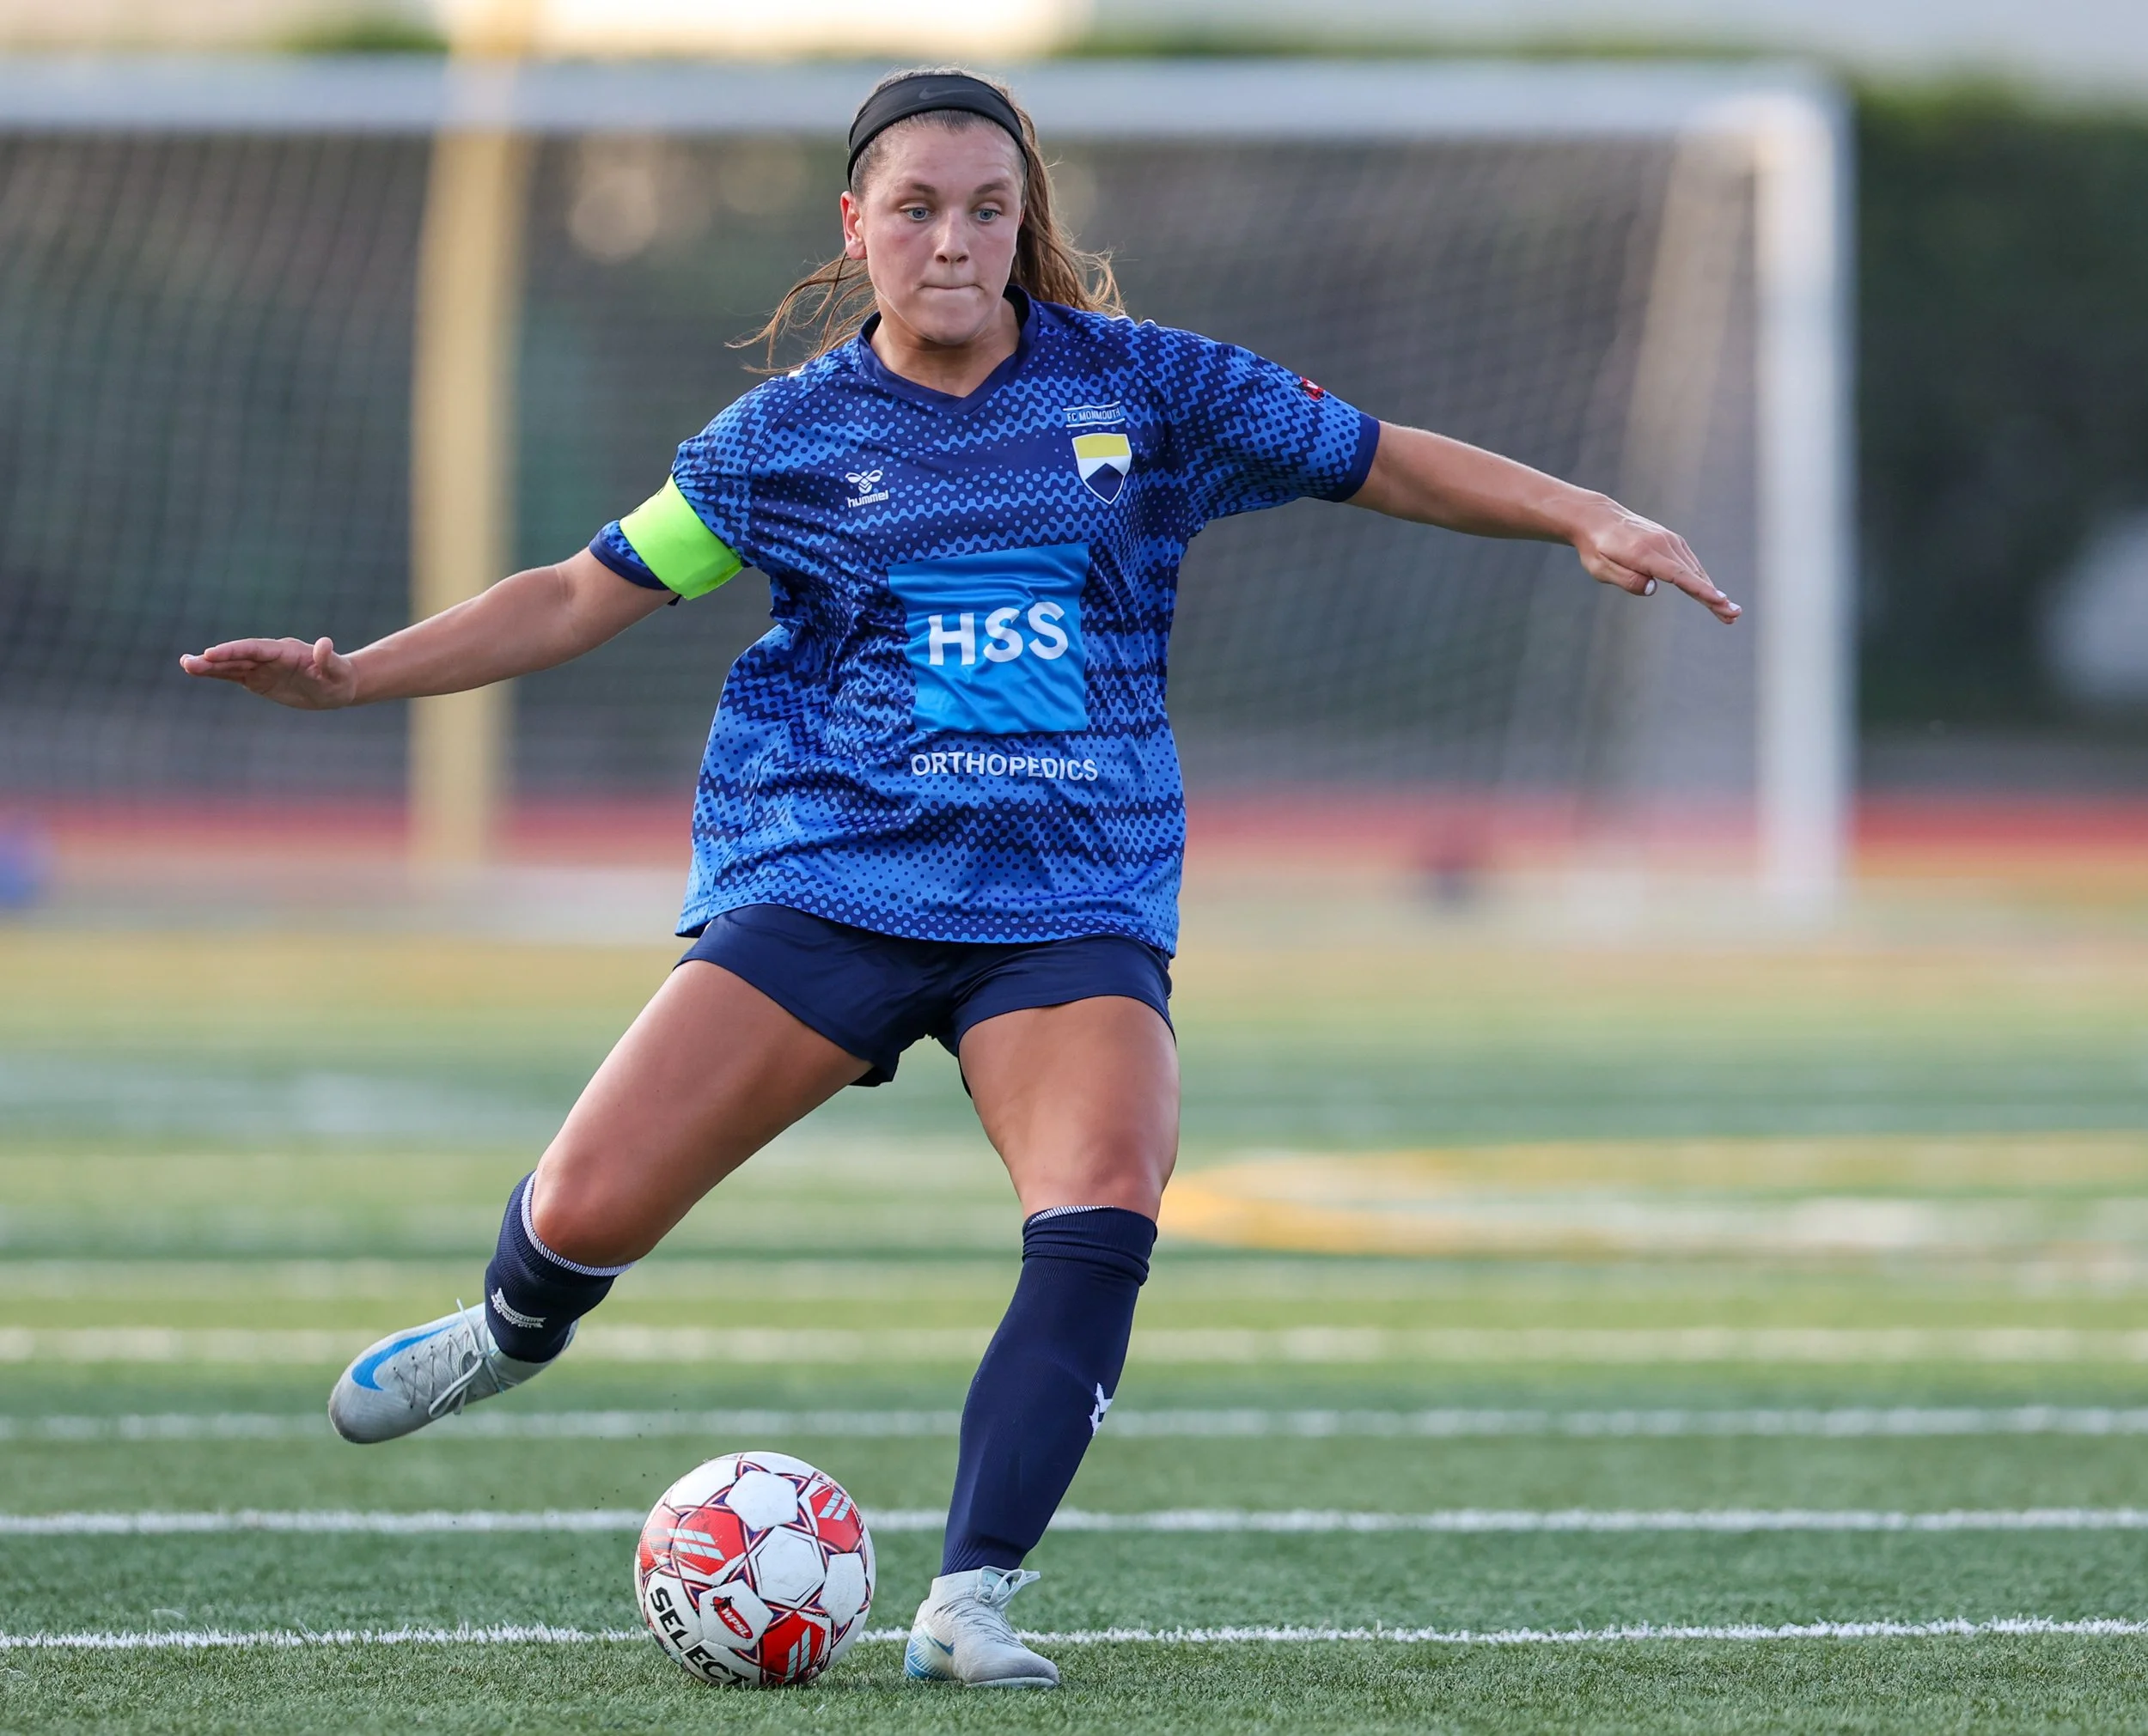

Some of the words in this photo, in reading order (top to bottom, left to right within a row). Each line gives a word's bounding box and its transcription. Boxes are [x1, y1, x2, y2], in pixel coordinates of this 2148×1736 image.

[1067, 412, 1077, 423] FC
[1079, 407, 1120, 421] MONMOUTH
[847, 490, 889, 508] hummel
[928, 601, 1069, 666] HSS
[911, 752, 1099, 781] ORTHOPEDICS
[650, 1587, 751, 1686] SELECT
[721, 1607, 749, 1637] WPSL
